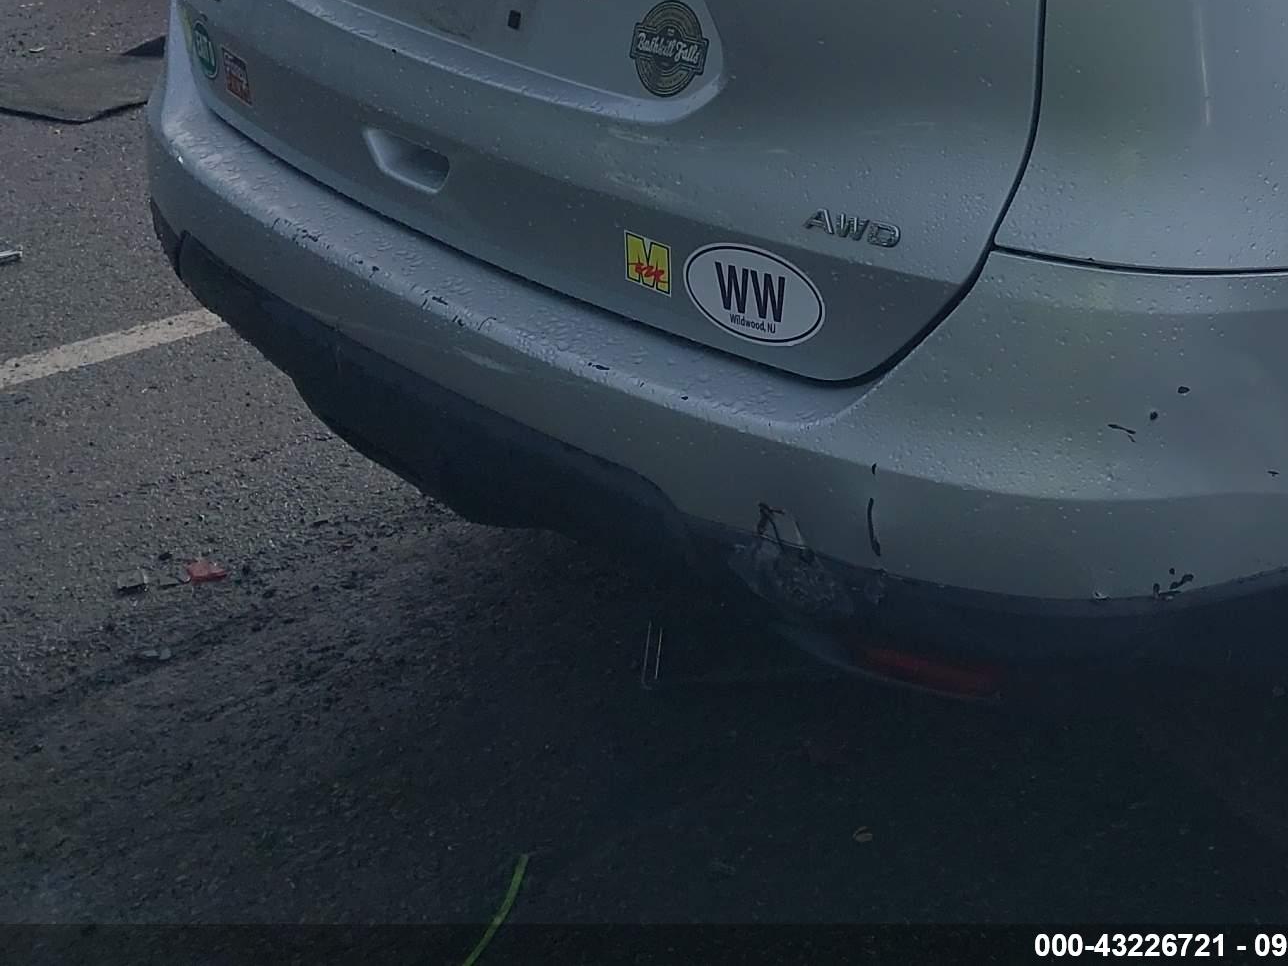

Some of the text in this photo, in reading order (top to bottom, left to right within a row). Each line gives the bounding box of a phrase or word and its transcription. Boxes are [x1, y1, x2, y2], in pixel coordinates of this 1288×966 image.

[803, 208, 901, 248] AWD
[715, 261, 786, 323] WW
[730, 313, 777, 335] Wildwood, NJ
